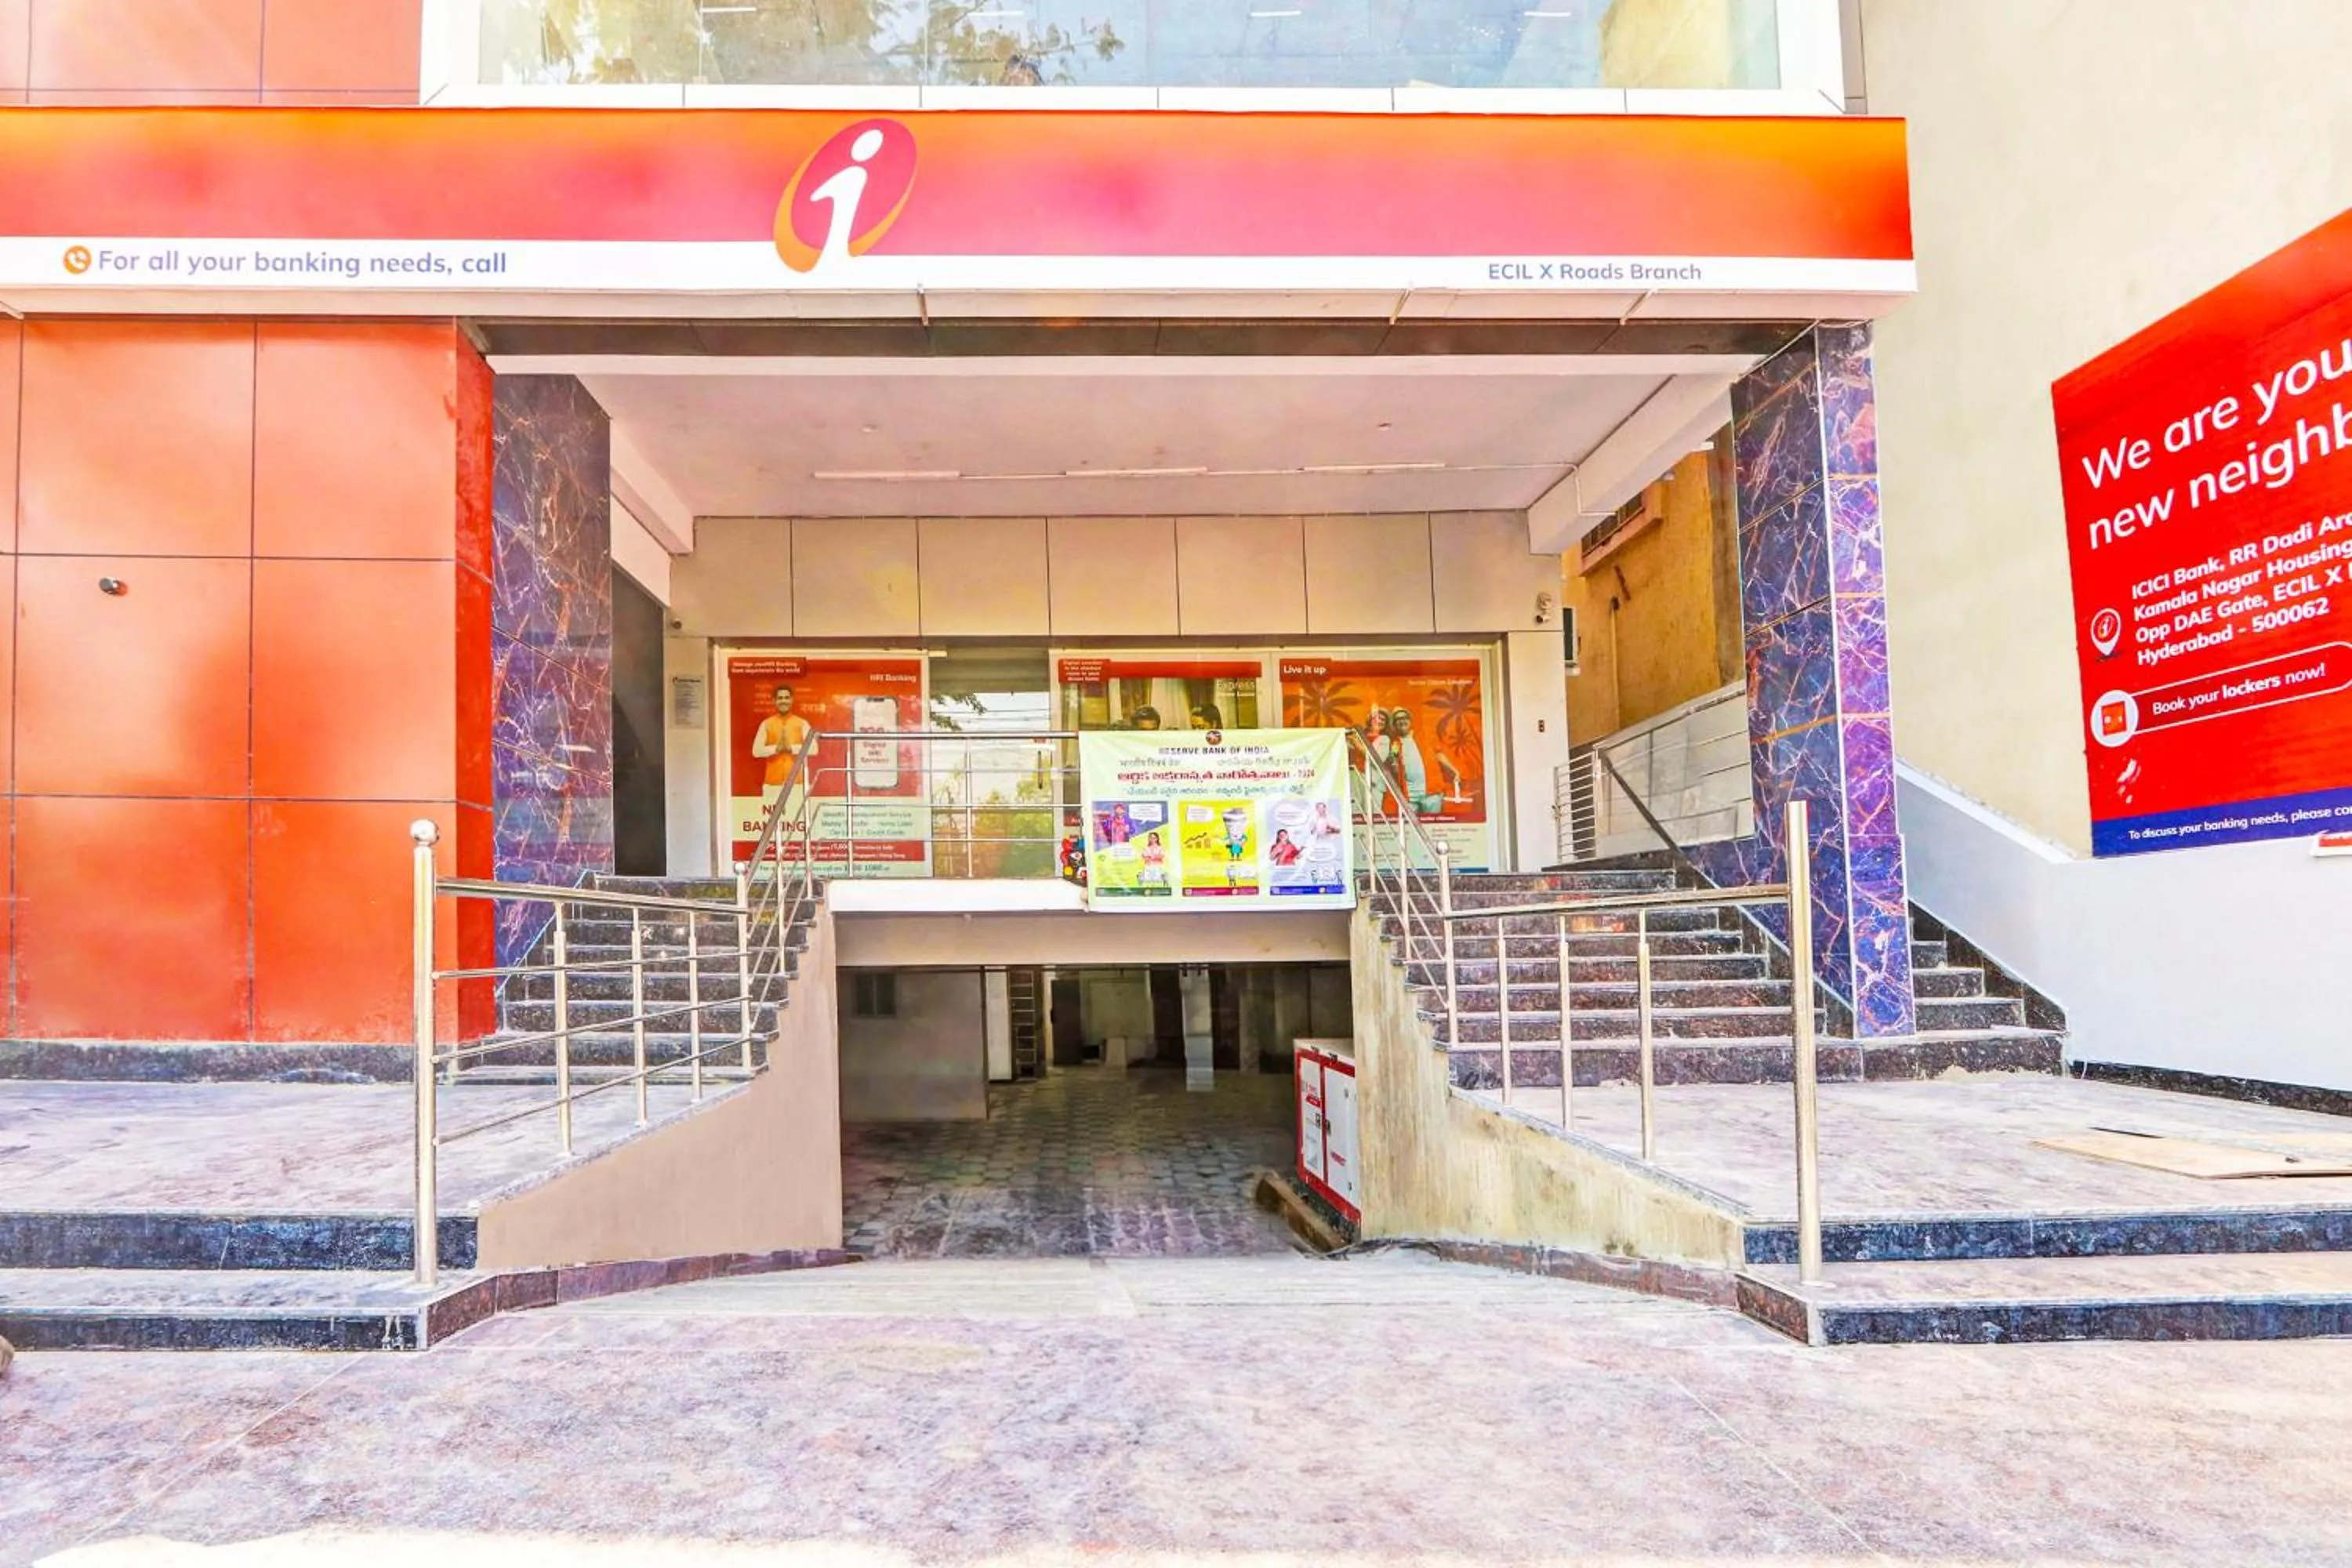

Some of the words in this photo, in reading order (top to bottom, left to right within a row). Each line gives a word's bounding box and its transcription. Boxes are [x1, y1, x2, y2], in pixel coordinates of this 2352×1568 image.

[98, 250, 140, 270] For
[148, 250, 179, 271] all
[187, 255, 247, 276] your
[254, 251, 361, 278] banking
[370, 252, 453, 275] needs,
[461, 252, 507, 273] call
[1489, 263, 1533, 280] ECIL
[1539, 263, 1554, 280] X
[1560, 263, 1624, 280] Roads
[1630, 263, 1702, 281] Branch
[2082, 437, 2151, 489] We
[2163, 395, 2240, 453] are
[2252, 338, 2352, 425] you
[2089, 488, 2175, 550] new
[2132, 573, 2170, 600] ICICI
[2229, 542, 2259, 566] RR
[2263, 521, 2314, 555] Dadi
[2133, 590, 2198, 622] Kamala
[2201, 568, 2262, 600] Nagar
[2135, 623, 2171, 644] Opp
[2173, 605, 2213, 632] DAE
[2216, 594, 2269, 618] Gate,
[2273, 573, 2321, 602] ECIL
[2324, 564, 2343, 587] X
[2136, 623, 2234, 666] Hyderabad
[2252, 596, 2330, 633] 500062
[885, 673, 916, 683] Banking
[1283, 664, 1302, 673] Live
[1304, 664, 1312, 673] it
[1313, 666, 1327, 676] up
[2151, 696, 2187, 716] Book
[2187, 690, 2220, 710] your
[2221, 675, 2281, 699] lockers
[2285, 662, 2327, 685] now!
[1202, 746, 1227, 755] BANK
[1244, 746, 1269, 754] INDIA
[742, 821, 806, 832] BAING
[2128, 829, 2141, 840] To
[2141, 826, 2177, 839] discuss
[2179, 823, 2202, 837] your
[2204, 818, 2249, 830] banking
[2290, 808, 2332, 824] please
[2334, 804, 2352, 816] co
